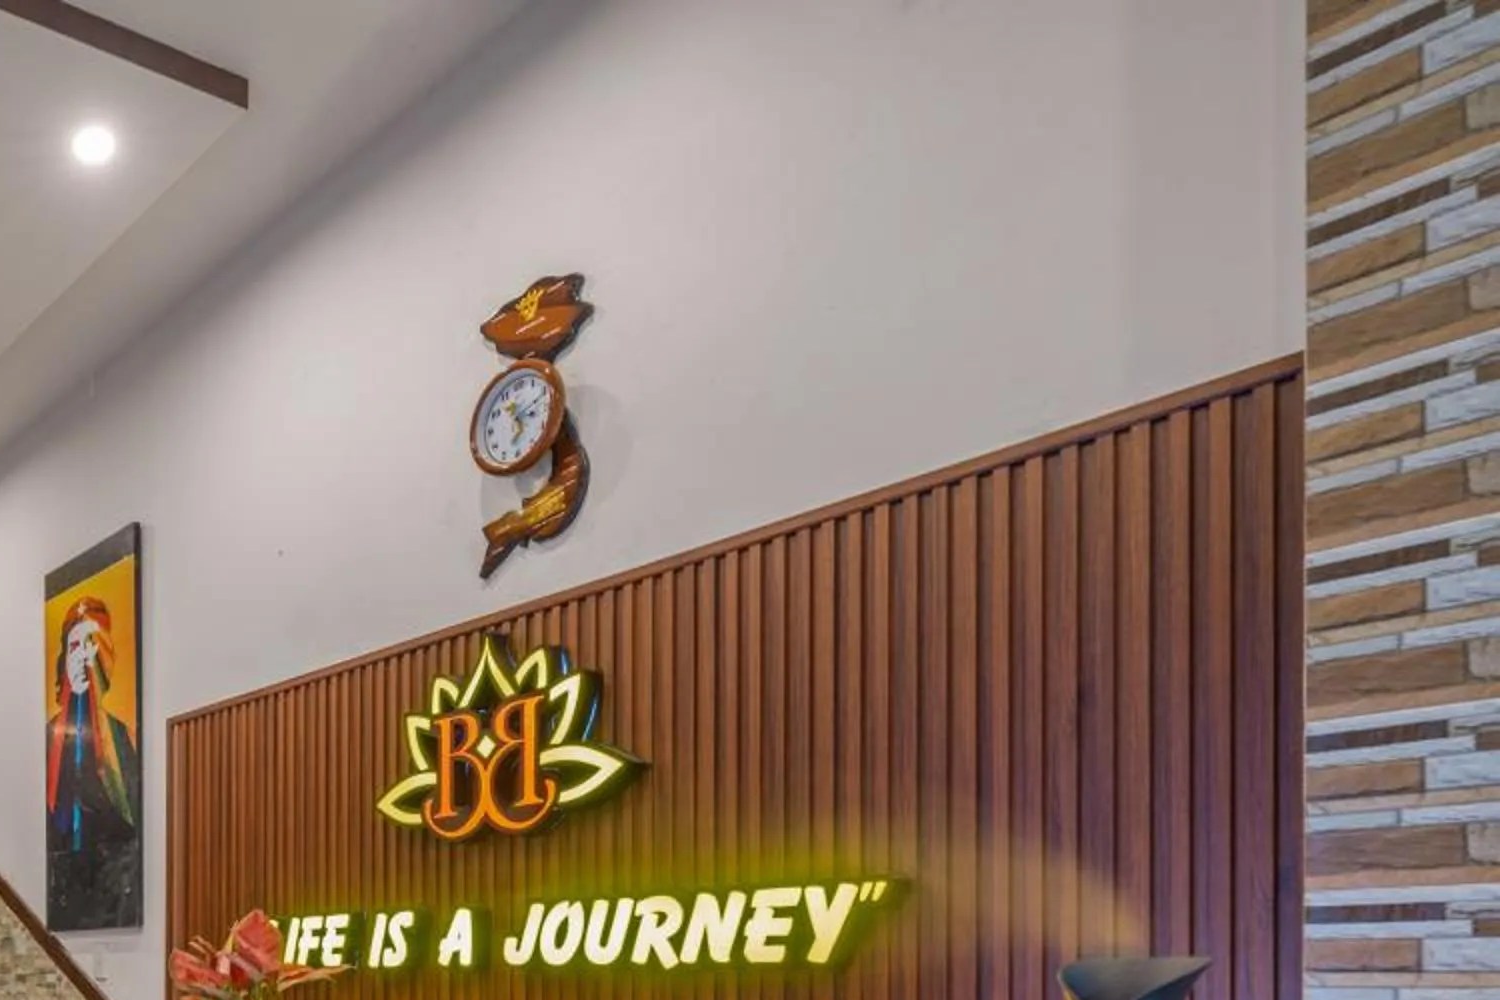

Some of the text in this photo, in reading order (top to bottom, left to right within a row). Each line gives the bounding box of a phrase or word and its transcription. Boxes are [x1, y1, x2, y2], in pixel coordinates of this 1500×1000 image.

[269, 912, 350, 968] IFE
[368, 911, 415, 968] IS
[438, 907, 473, 967] A
